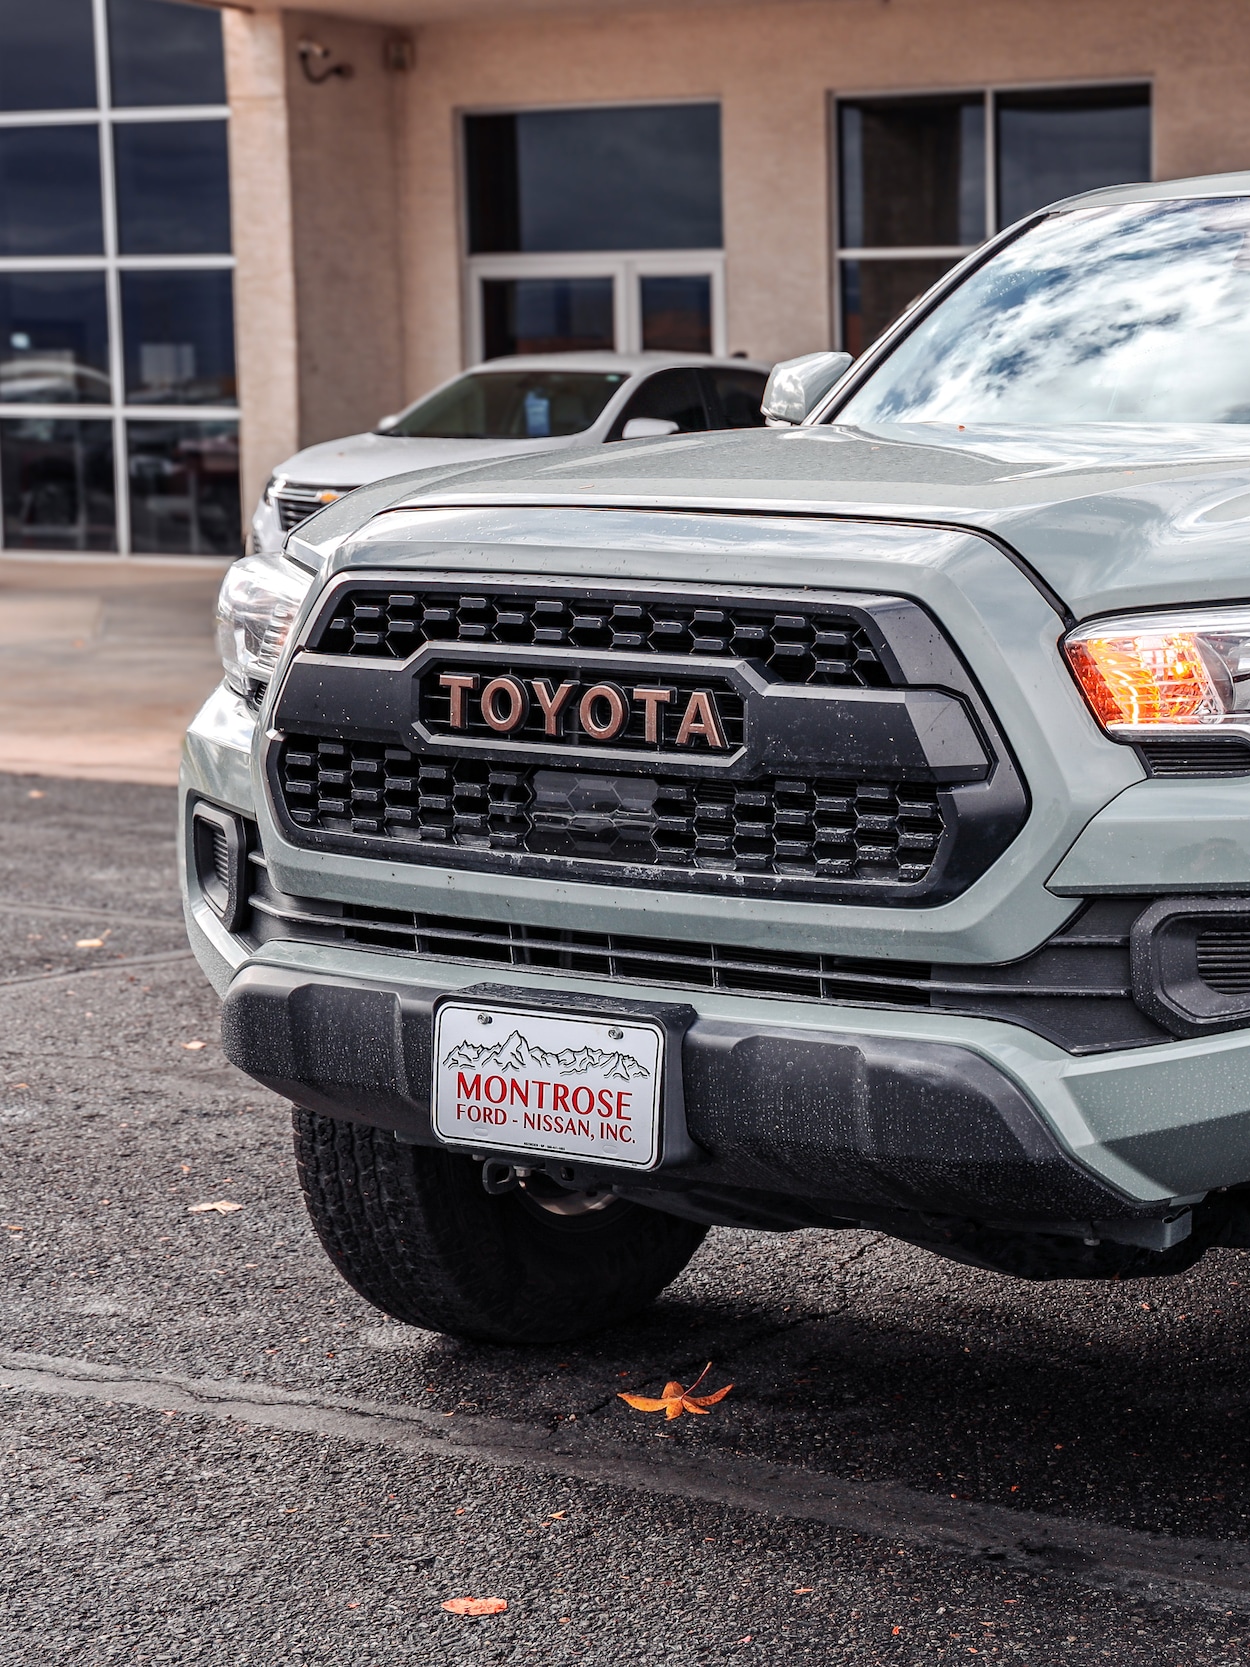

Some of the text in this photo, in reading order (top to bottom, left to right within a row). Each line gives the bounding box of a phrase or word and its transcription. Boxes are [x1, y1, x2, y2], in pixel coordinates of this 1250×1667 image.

[439, 672, 728, 748] TOYOTA
[457, 1071, 633, 1121] MONTROSE
[456, 1103, 507, 1125] FORD
[524, 1112, 595, 1141] NISSAN,
[600, 1122, 636, 1144] INC.
